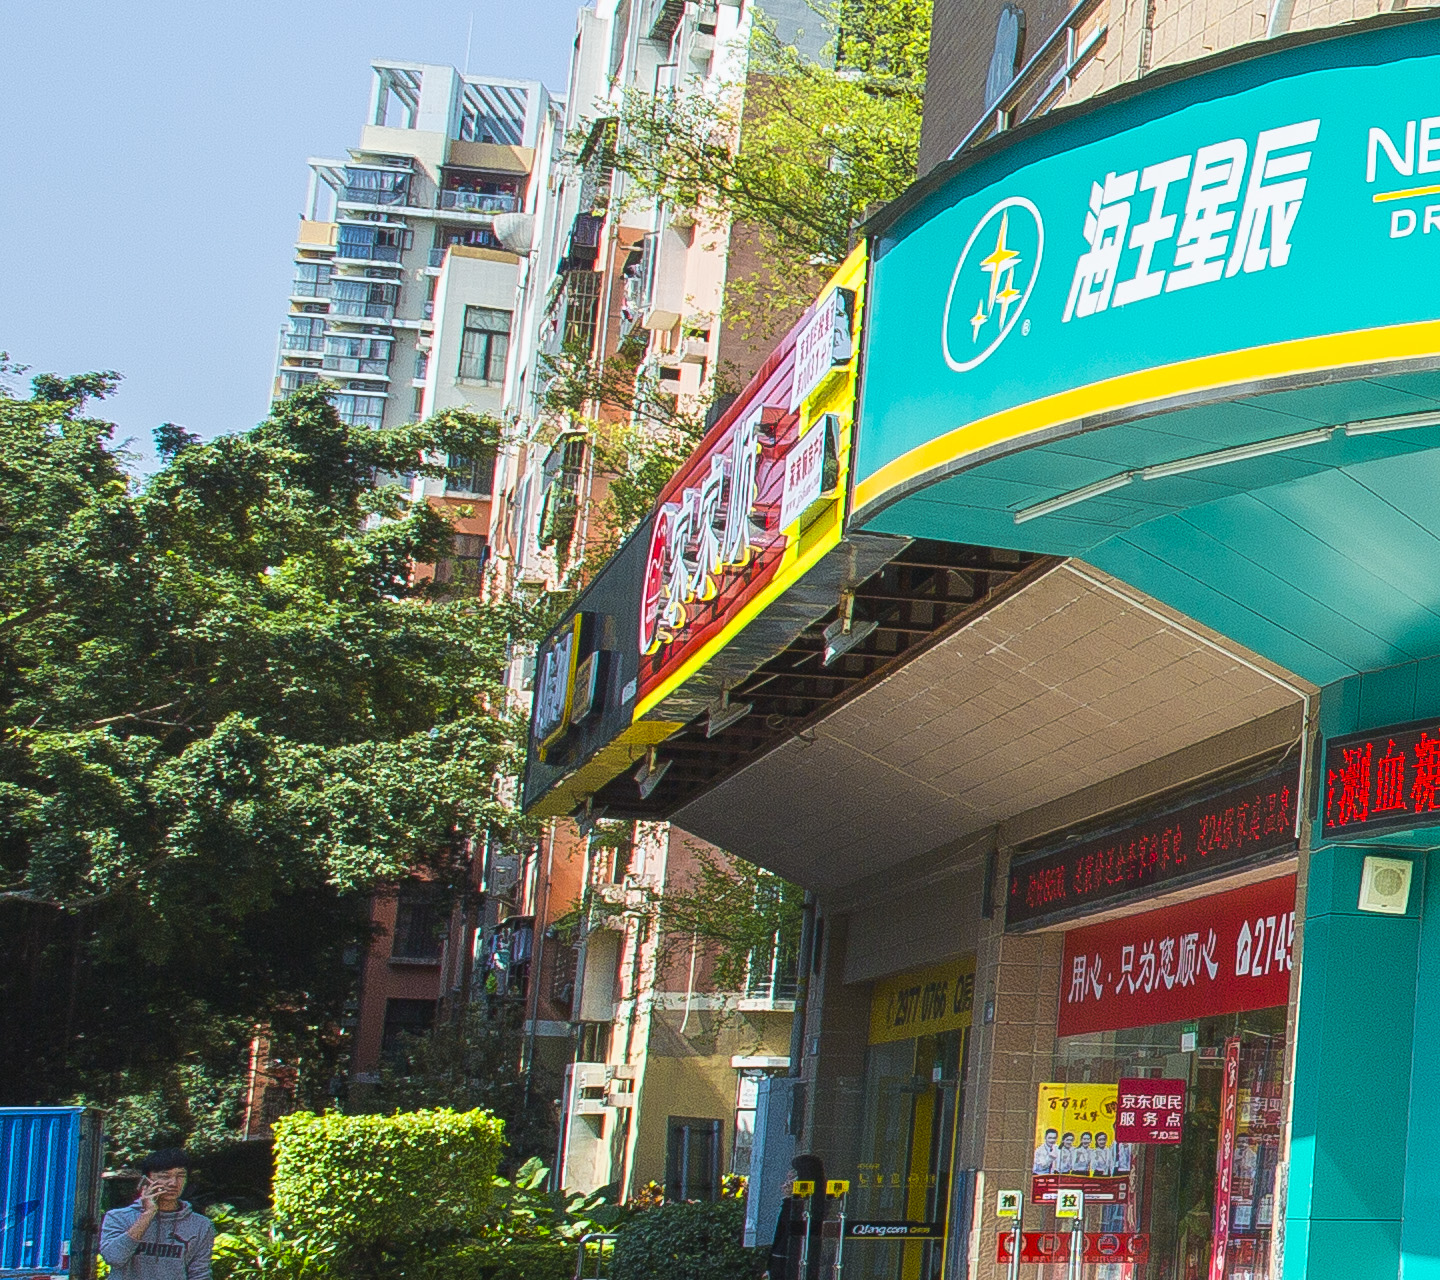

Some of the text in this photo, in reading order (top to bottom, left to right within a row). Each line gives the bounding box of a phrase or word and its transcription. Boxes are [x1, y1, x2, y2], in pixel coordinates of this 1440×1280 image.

[1062, 118, 1321, 322] 海王星辰
[662, 406, 760, 628] 家家顺
[1121, 1094, 1182, 1110] 京东便民
[1119, 1112, 1181, 1127] 服务点
[136, 1241, 183, 1259] PUMA
